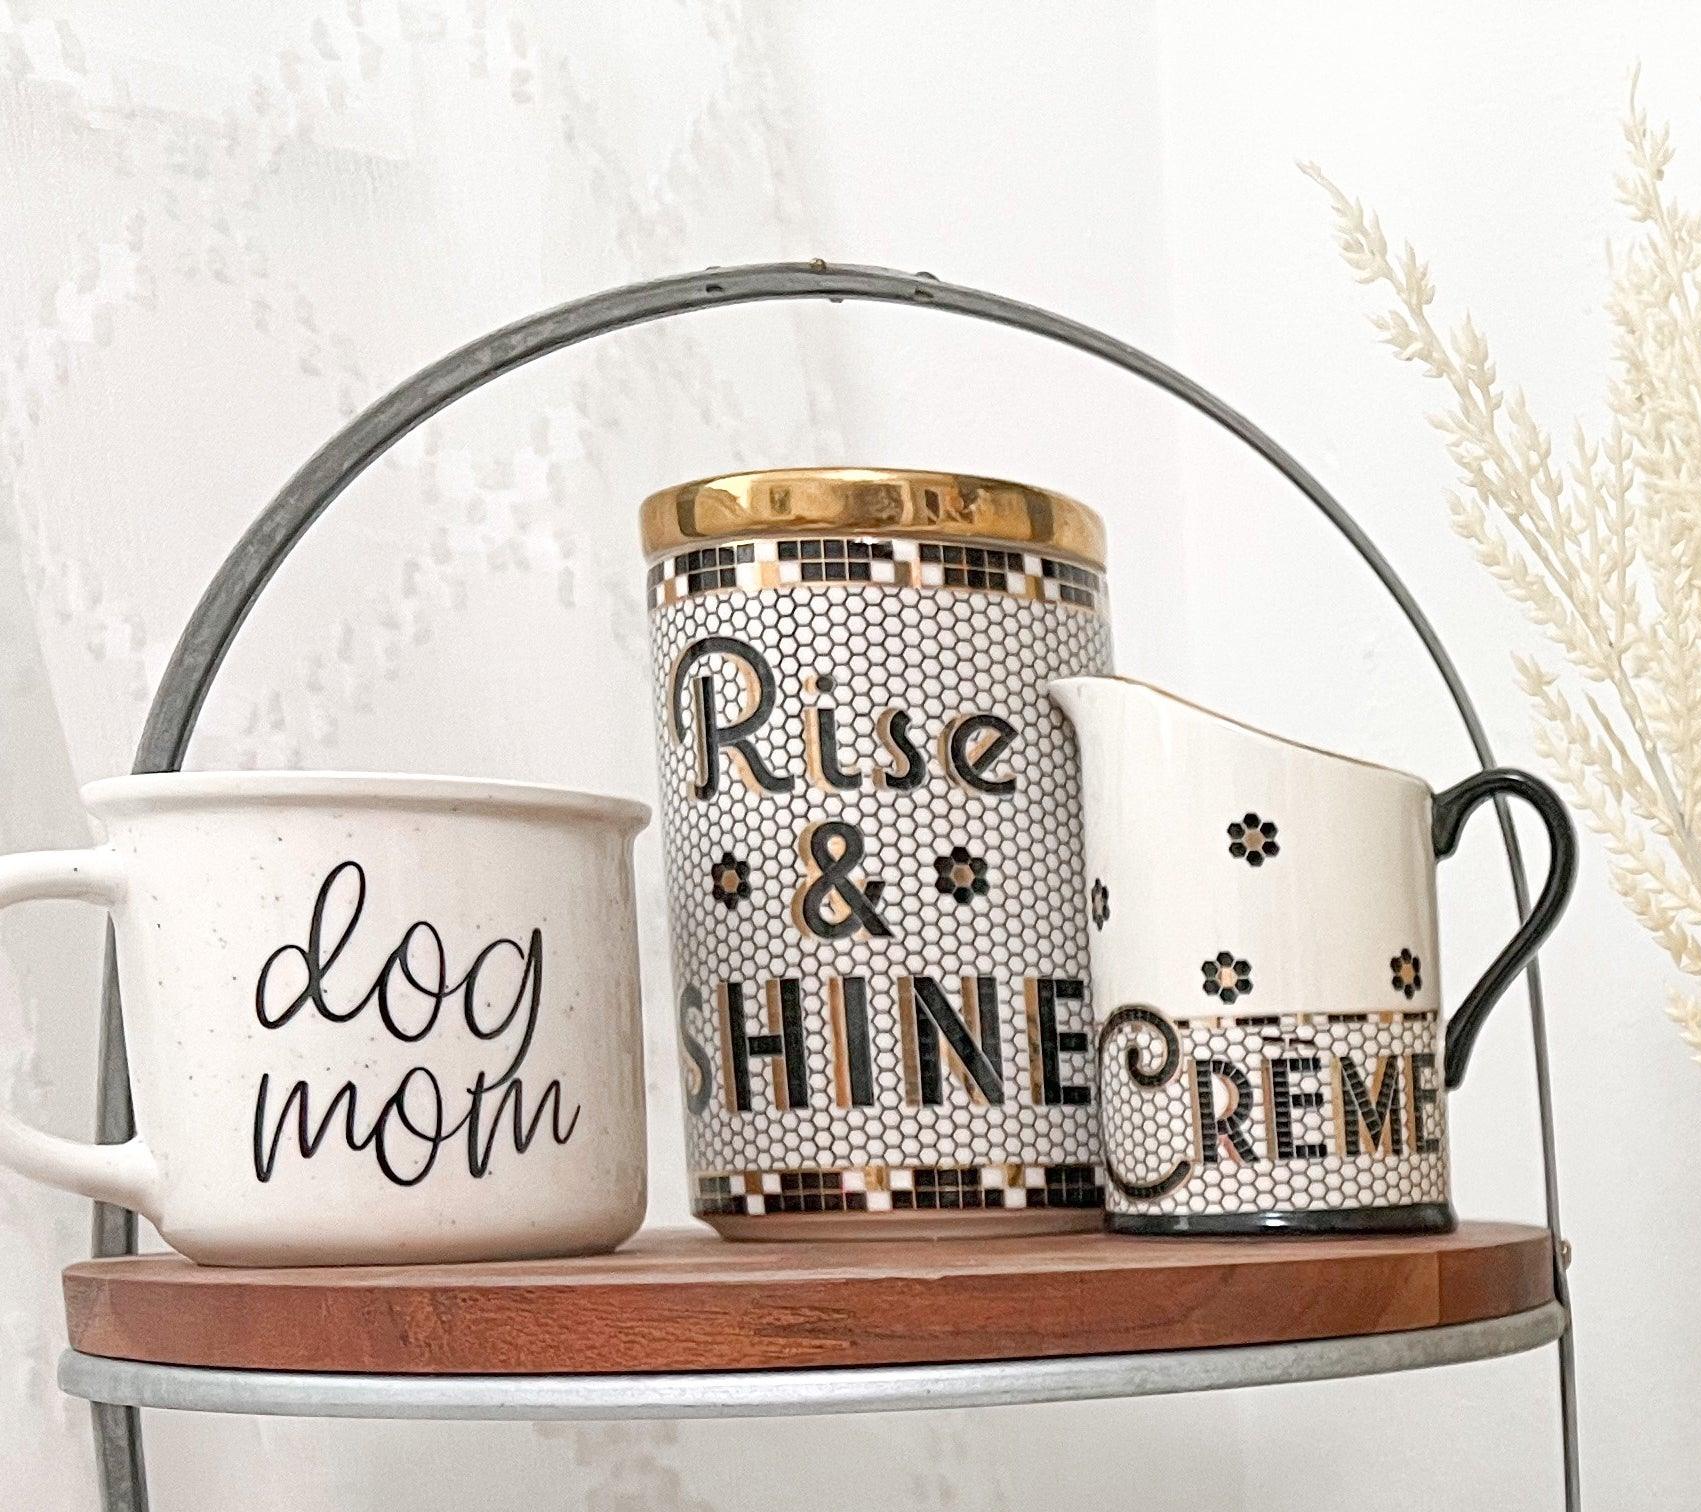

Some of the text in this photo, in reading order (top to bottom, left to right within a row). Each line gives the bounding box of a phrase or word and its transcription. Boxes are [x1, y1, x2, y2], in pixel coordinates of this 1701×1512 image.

[671, 635, 1019, 800] Rise
[790, 820, 896, 940] &
[255, 861, 543, 1095] dog
[679, 976, 1092, 1113] SHINE
[253, 1066, 581, 1187] mom
